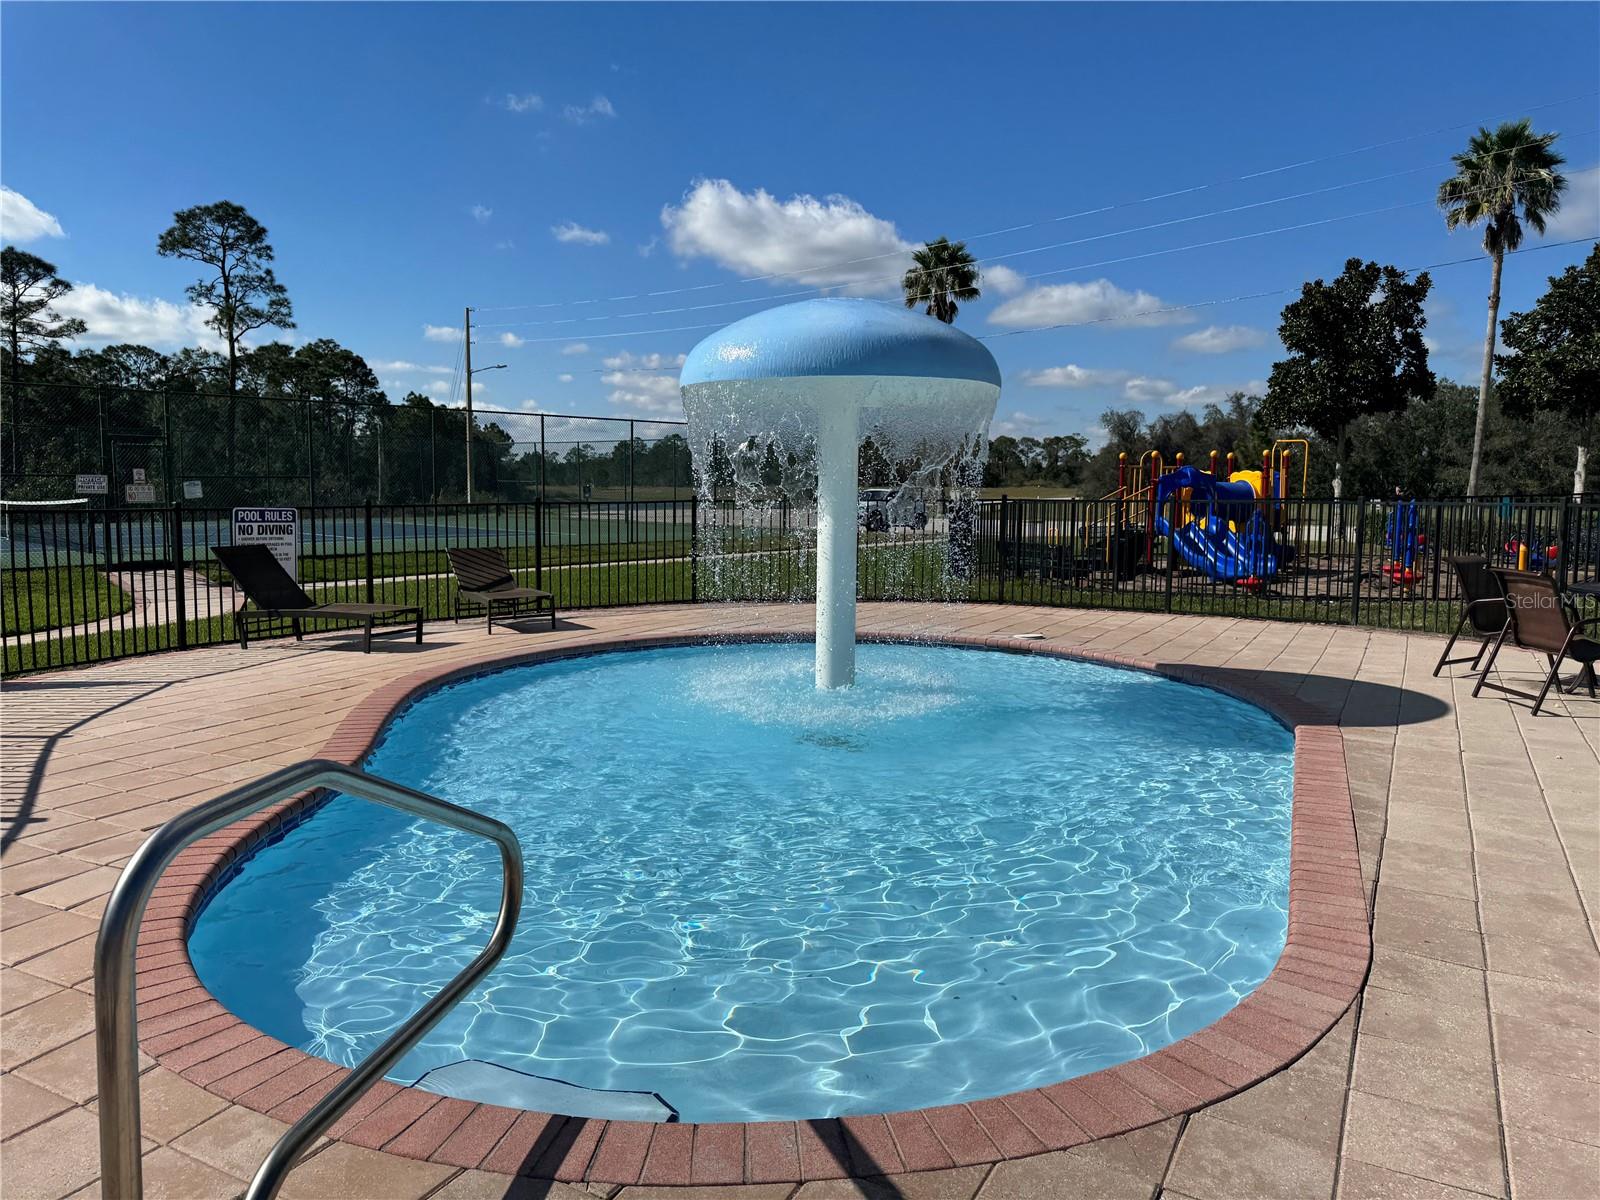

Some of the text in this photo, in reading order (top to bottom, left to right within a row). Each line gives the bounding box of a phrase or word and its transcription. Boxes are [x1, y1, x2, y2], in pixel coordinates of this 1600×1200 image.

[238, 511, 293, 521] POOL RULES
[238, 524, 293, 535] NO DIVING
